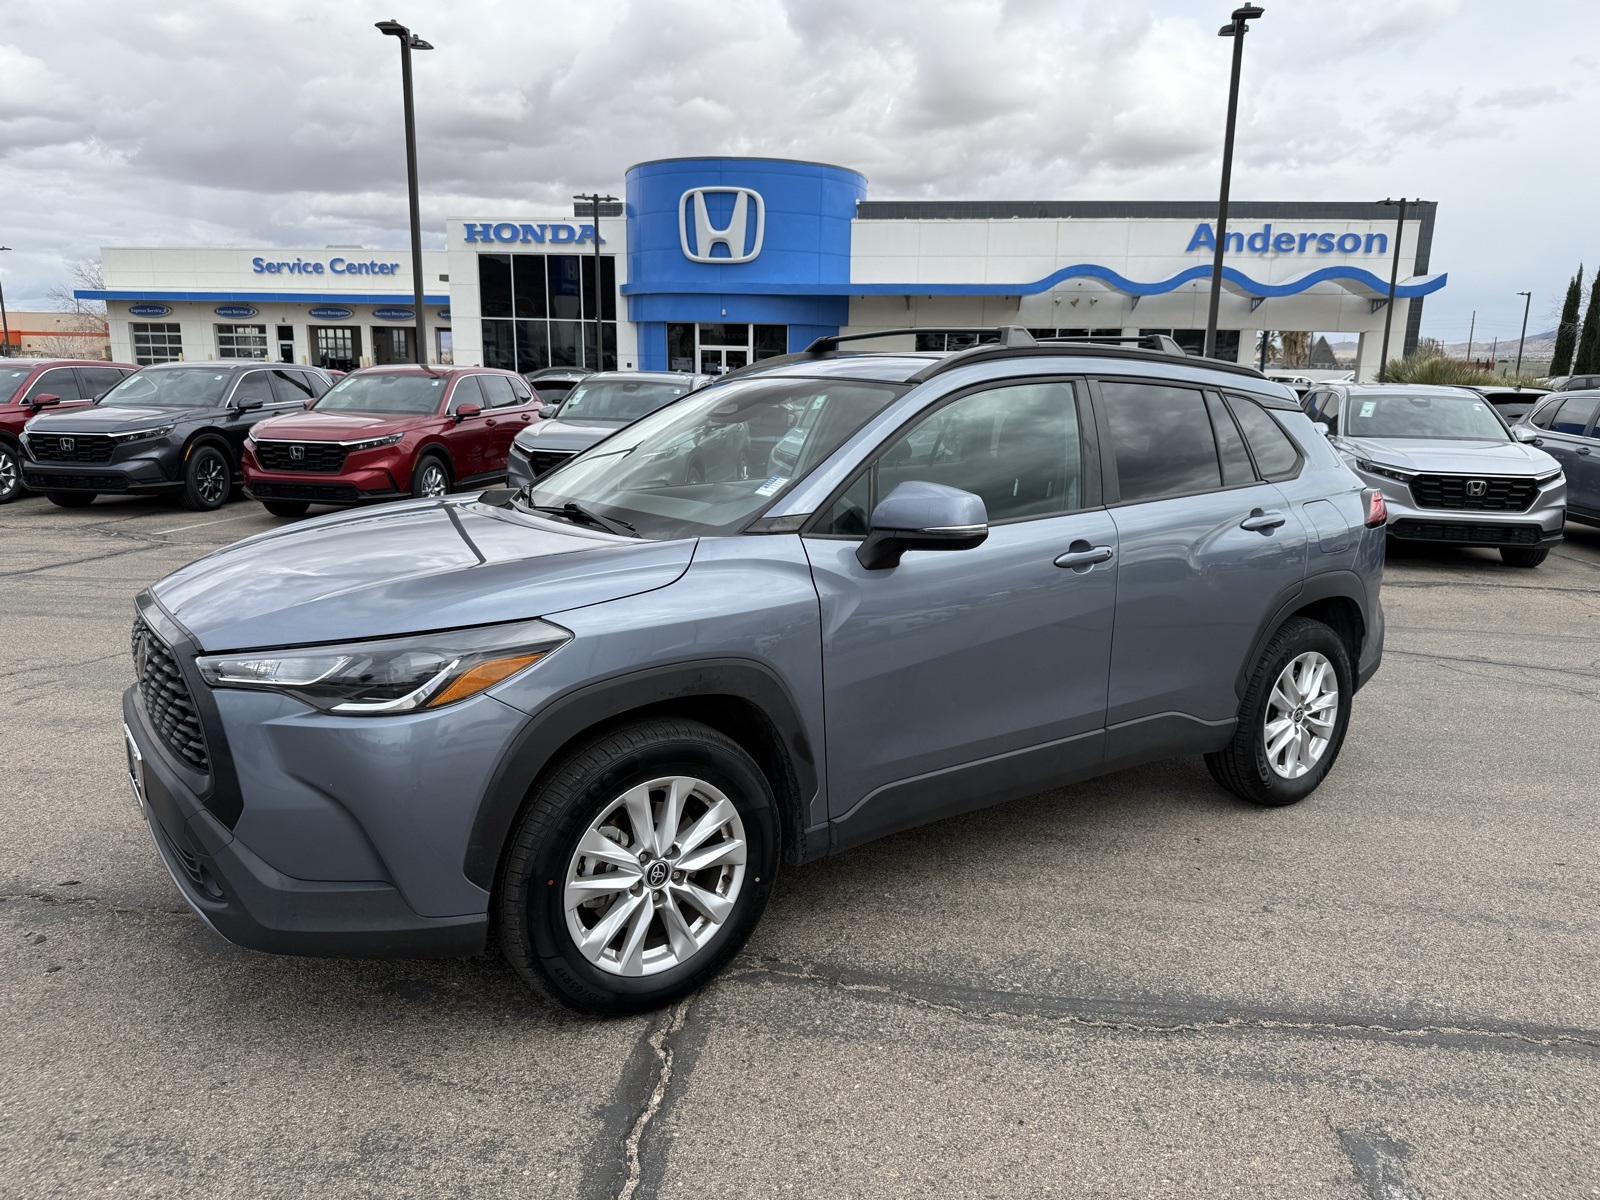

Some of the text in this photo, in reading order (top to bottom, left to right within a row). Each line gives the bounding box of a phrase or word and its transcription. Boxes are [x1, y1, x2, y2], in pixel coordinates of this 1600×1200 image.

[463, 222, 606, 244] HONDA
[1185, 223, 1388, 254] Anderson
[252, 256, 399, 275] Service Center
